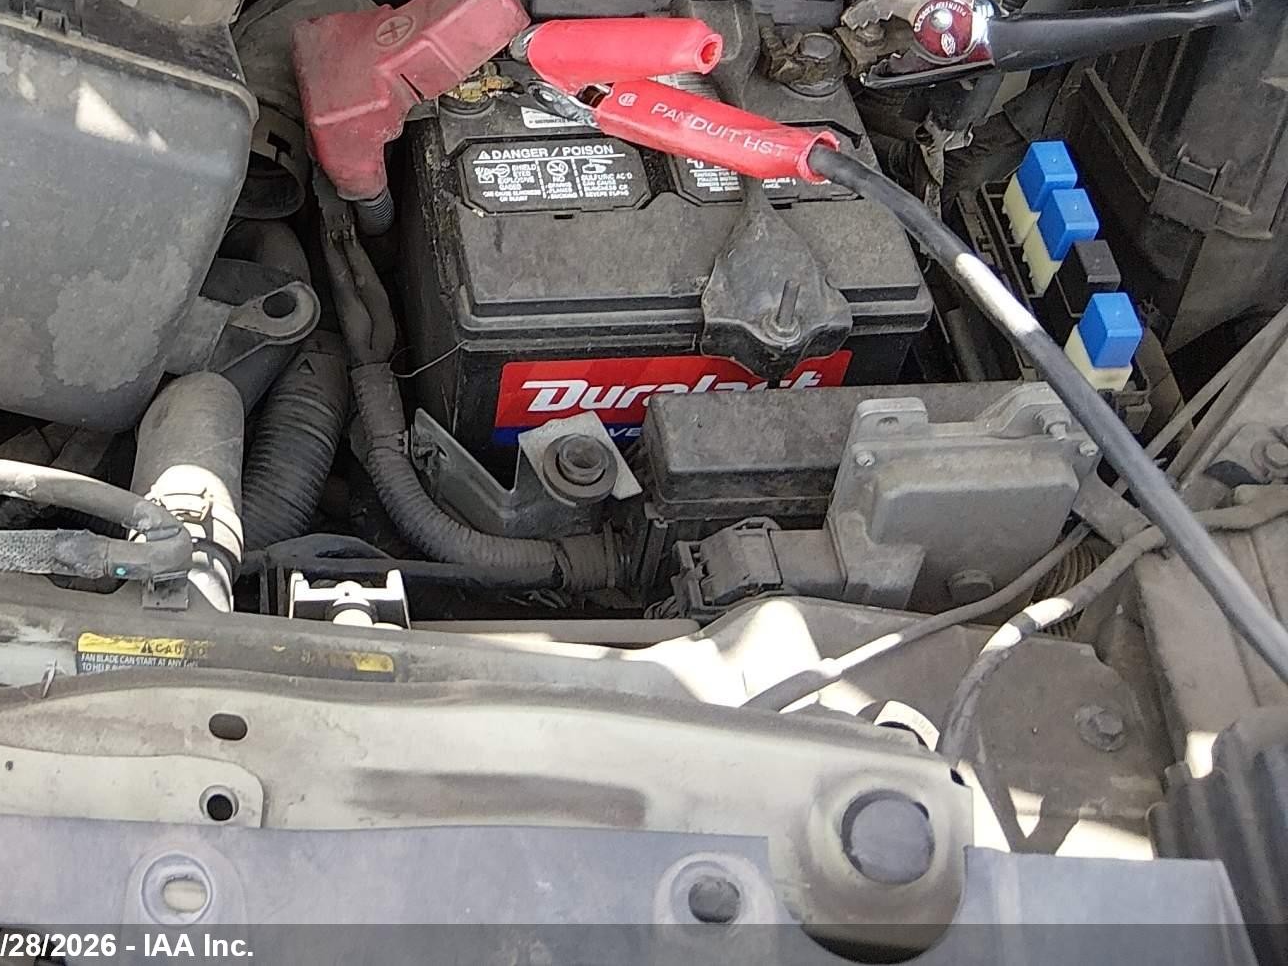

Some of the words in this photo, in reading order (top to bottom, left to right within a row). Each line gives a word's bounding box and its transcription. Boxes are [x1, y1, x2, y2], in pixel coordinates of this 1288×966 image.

[650, 102, 744, 142] PANDUIT
[743, 135, 789, 157] HST
[492, 147, 548, 160] DANGER
[562, 145, 614, 156] POISON
[522, 370, 822, 412] Duralt
[81, 652, 96, 663] FAN
[96, 654, 119, 664] BLADE
[120, 655, 135, 665] CAN
[136, 656, 157, 666] START
